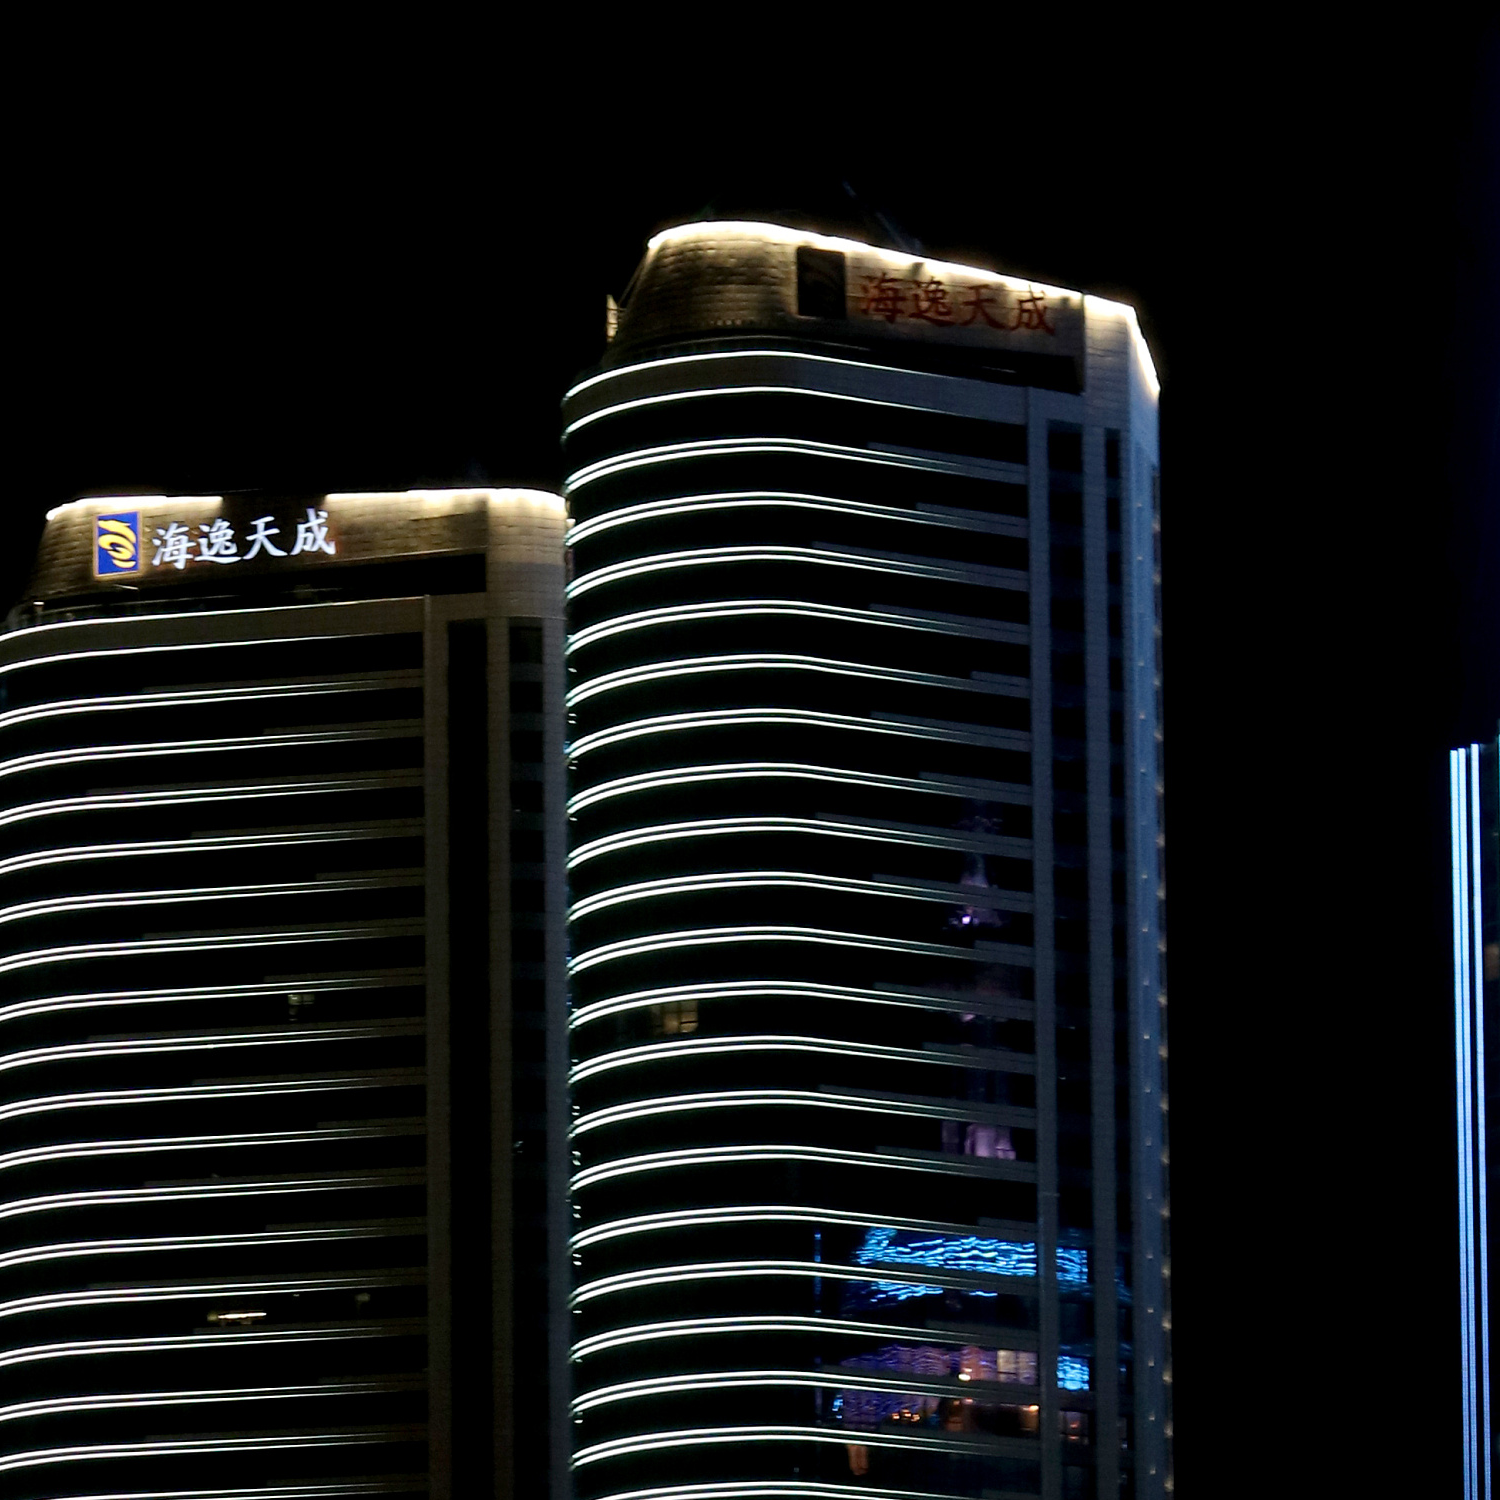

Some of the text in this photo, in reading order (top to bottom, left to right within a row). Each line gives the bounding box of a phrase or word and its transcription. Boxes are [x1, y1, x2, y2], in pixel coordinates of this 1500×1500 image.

[857, 271, 1056, 336] 海逸天成
[150, 507, 338, 571] 海逸天成
